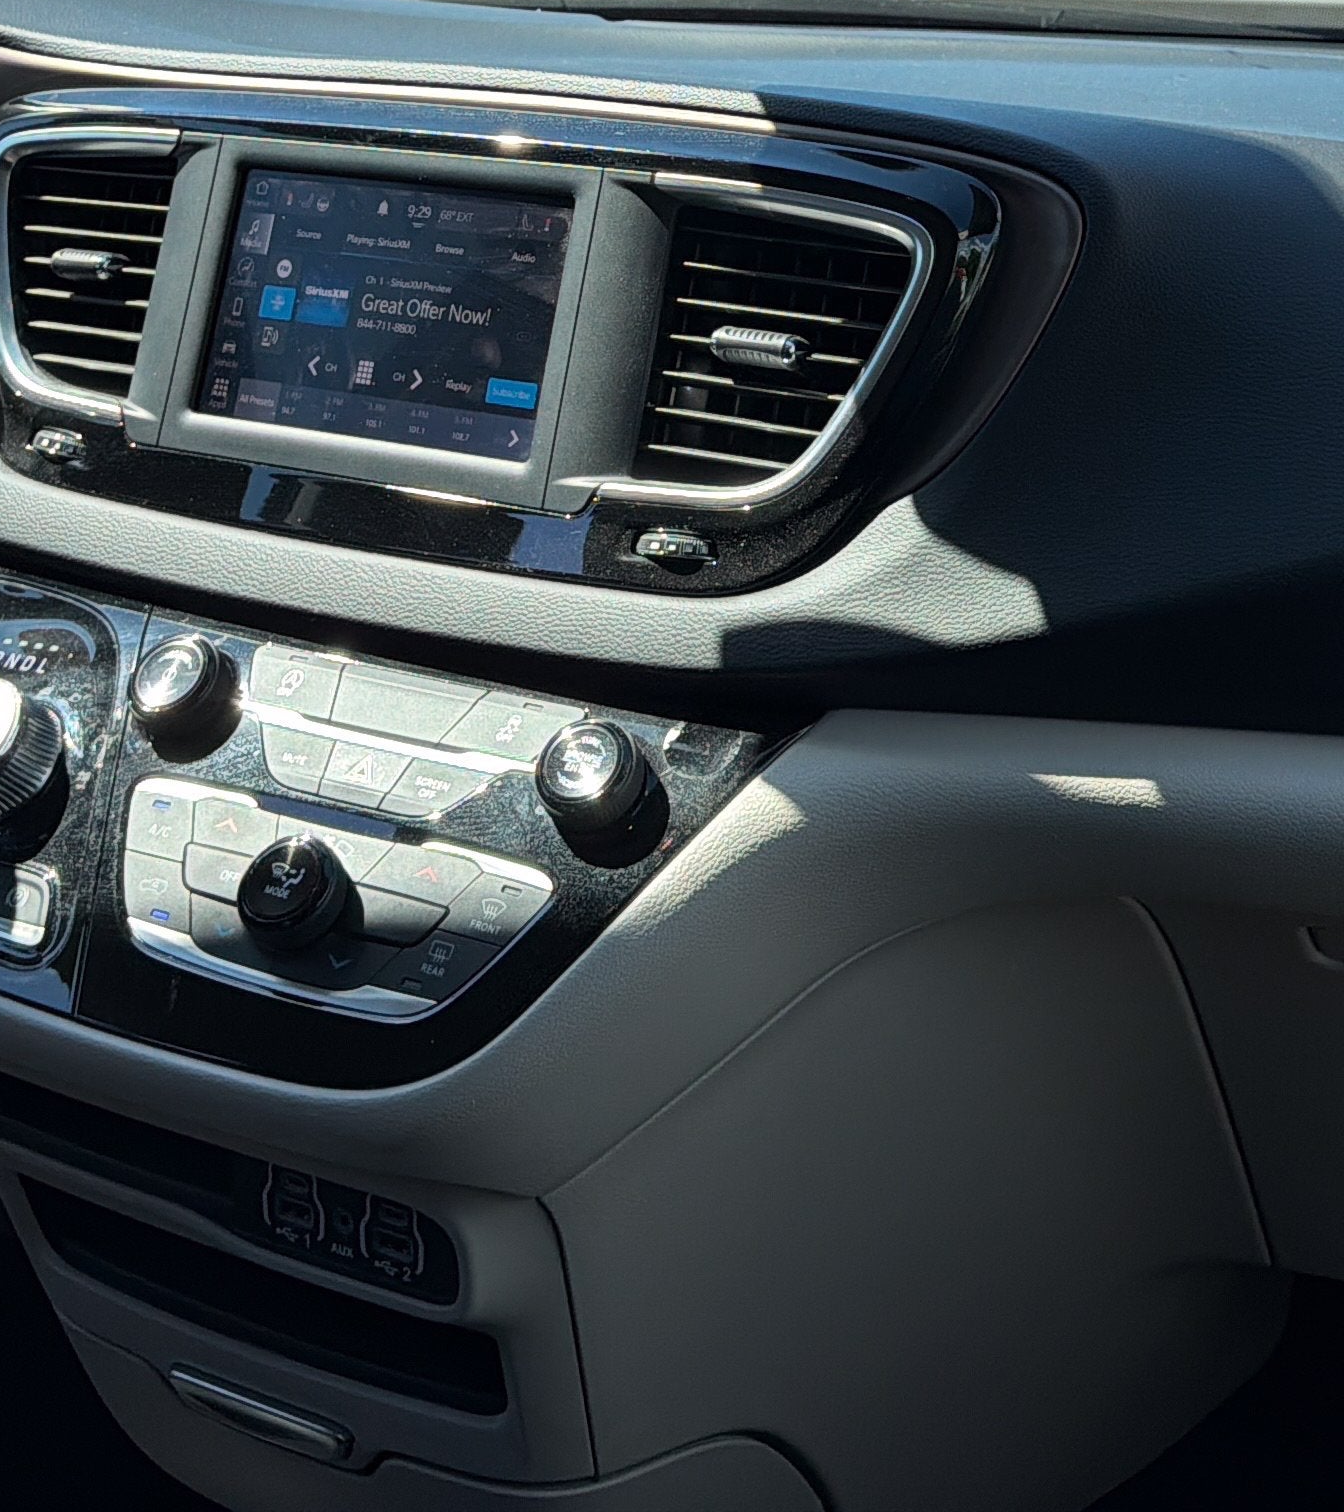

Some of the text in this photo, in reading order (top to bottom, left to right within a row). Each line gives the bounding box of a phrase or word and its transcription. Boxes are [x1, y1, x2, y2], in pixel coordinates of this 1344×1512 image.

[408, 204, 432, 219] 9:29
[296, 229, 536, 264] Source Playing: SiriusXM Browse Audio
[305, 286, 349, 299] SiriusXM
[423, 282, 452, 293] Preview
[361, 293, 492, 326] Great Offer Now!
[325, 363, 337, 373] CH
[393, 372, 405, 382] CH
[445, 379, 472, 393] Replay
[239, 394, 275, 407] All Presets
[416, 775, 451, 793] SCREEN
[417, 788, 436, 800] OFF
[148, 823, 172, 838] A/C
[265, 886, 290, 901] MODE
[470, 919, 502, 935] FRONT
[421, 964, 445, 978] REAR
[305, 1233, 310, 1248] 1
[330, 1243, 354, 1258] AUX
[402, 1266, 412, 1282] 2
